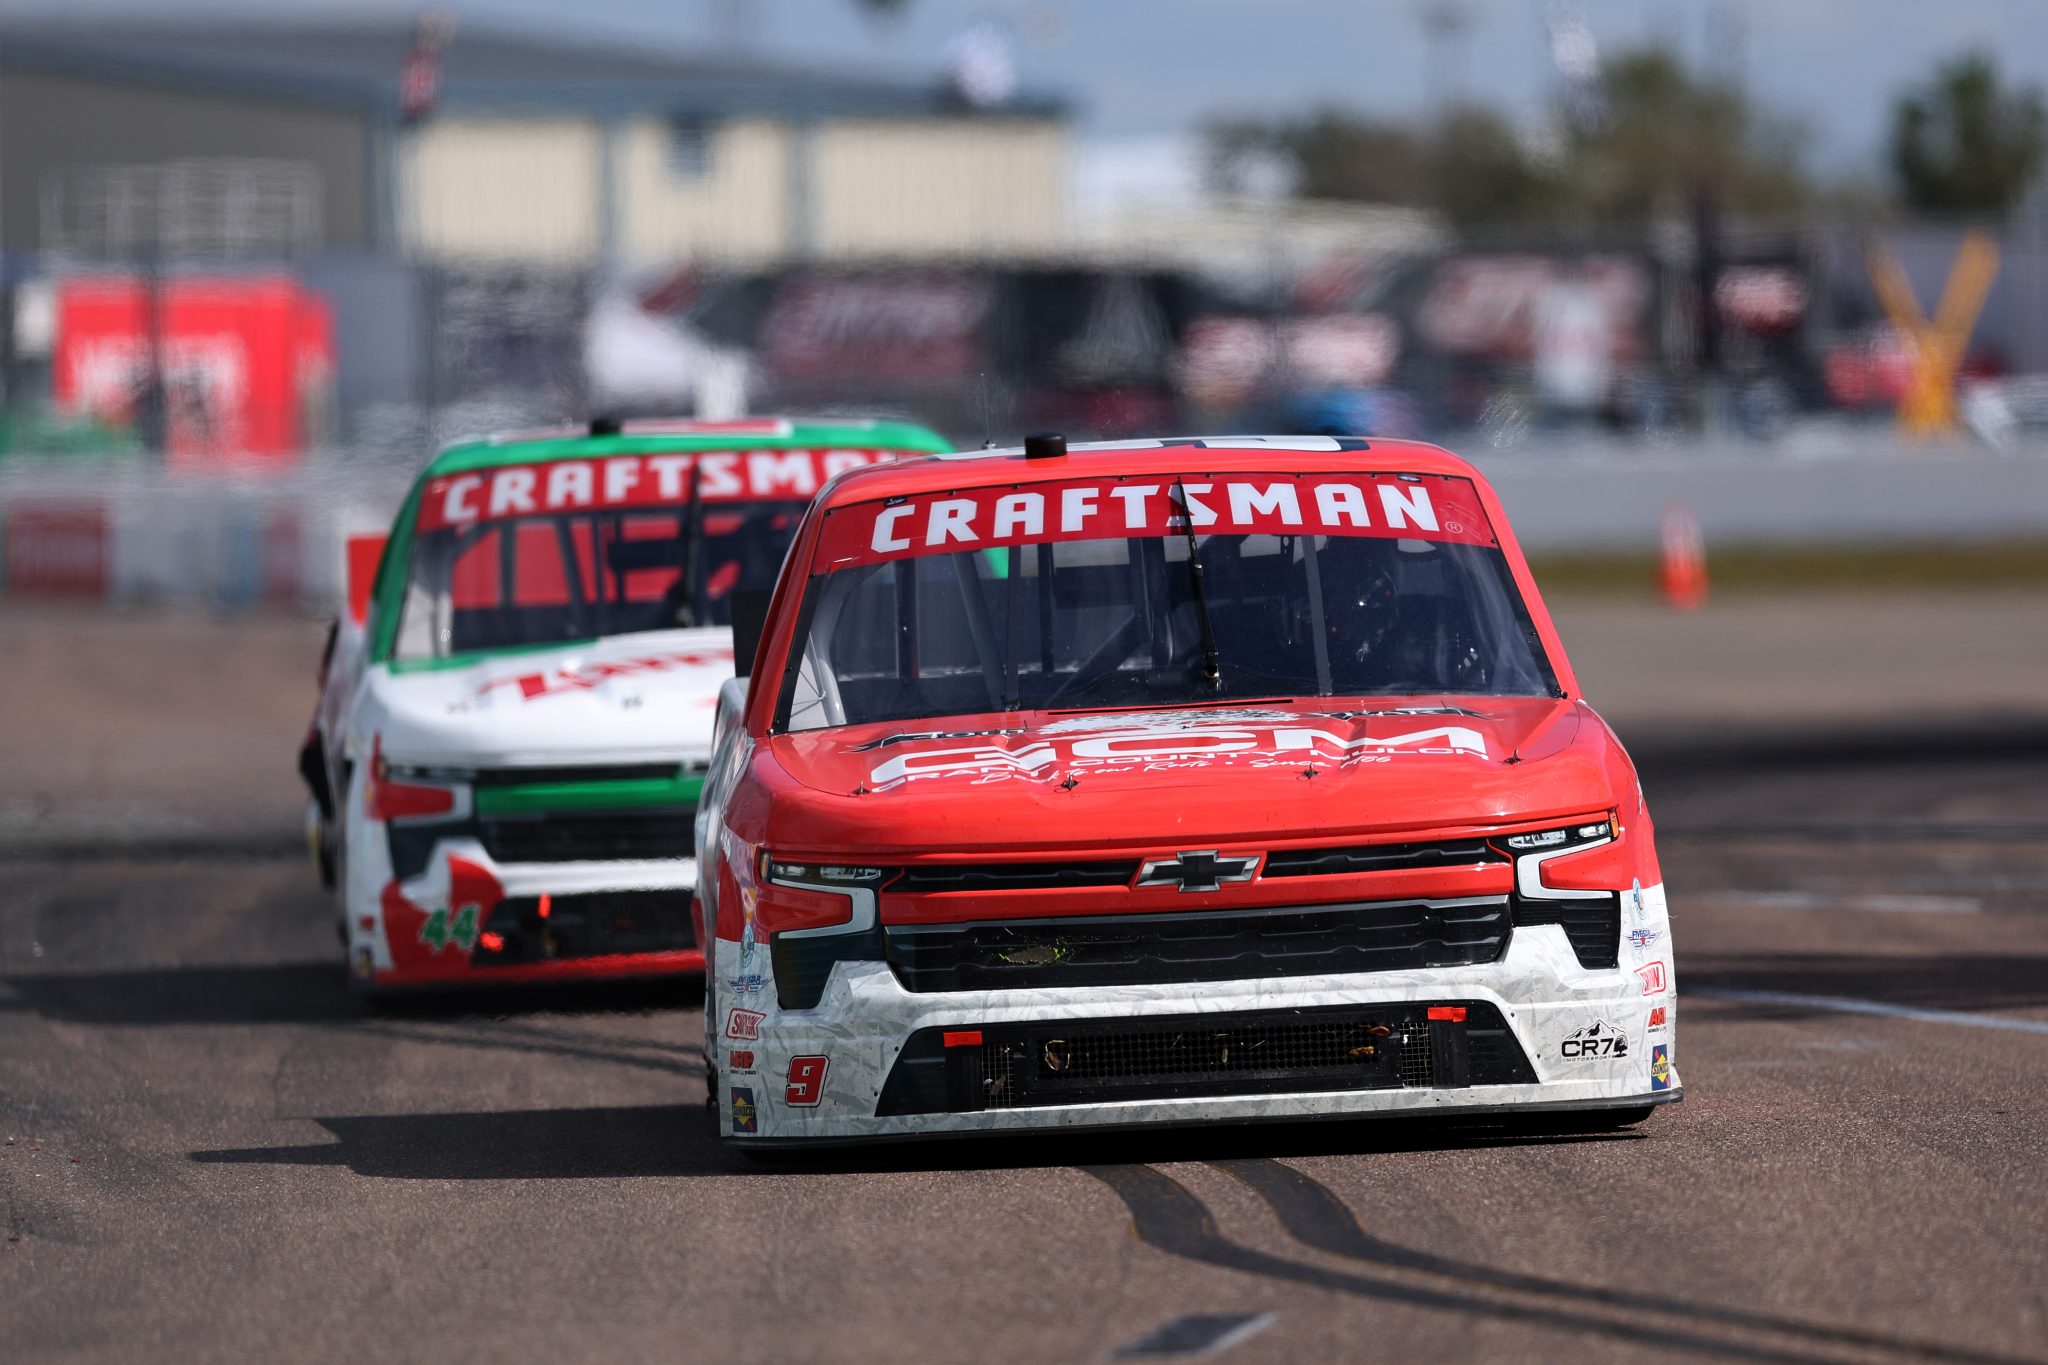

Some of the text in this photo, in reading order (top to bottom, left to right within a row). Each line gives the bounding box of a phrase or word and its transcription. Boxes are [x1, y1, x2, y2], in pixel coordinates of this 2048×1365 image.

[443, 450, 897, 523] CRAFTSMA
[871, 482, 1440, 553] CRAFTSMAN
[871, 727, 1487, 783] GCM
[1070, 750, 1289, 767] COUNTY
[1143, 759, 1212, 773] Roots
[419, 903, 481, 954] 44
[1561, 1037, 1614, 1058] CR7
[785, 1055, 830, 1108] 9
